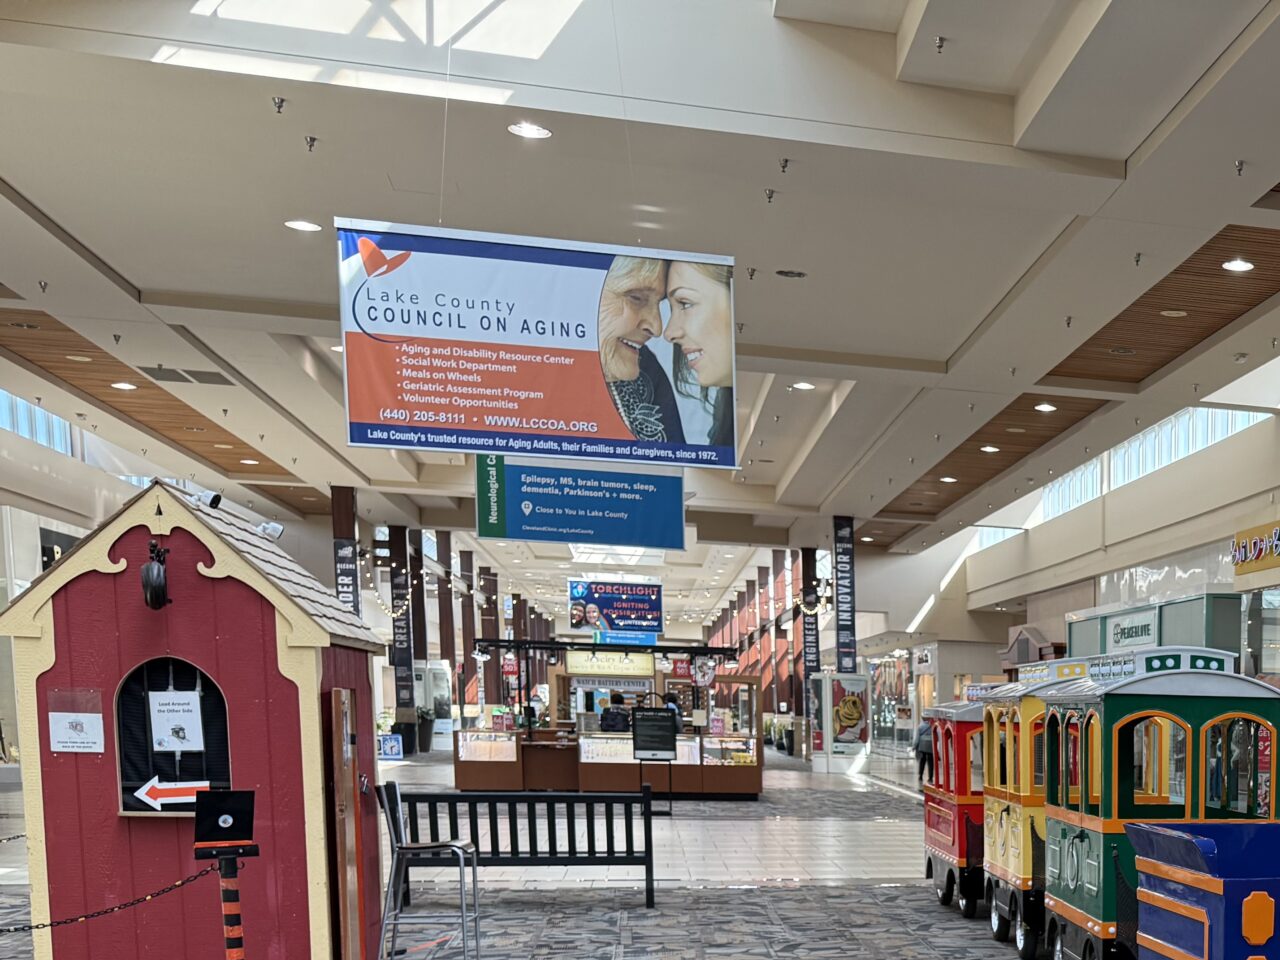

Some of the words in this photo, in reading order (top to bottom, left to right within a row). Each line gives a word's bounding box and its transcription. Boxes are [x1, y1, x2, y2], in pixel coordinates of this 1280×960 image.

[366, 287, 420, 305] Lake
[434, 293, 516, 316] County
[367, 305, 467, 329] COUNCIL
[480, 315, 507, 333] ON
[520, 318, 587, 339] AGING
[401, 343, 430, 356] Aging
[432, 345, 451, 355] and
[452, 346, 498, 361] Disability
[500, 350, 542, 363] Resource
[543, 354, 575, 366] Center
[401, 355, 430, 366] Social
[432, 357, 457, 369] Work
[459, 360, 517, 373] Department
[402, 368, 431, 379] Meals
[433, 372, 445, 380] on
[446, 370, 482, 383] Wheels
[402, 380, 445, 392] Geriatric
[446, 383, 502, 396] Assessment
[503, 387, 544, 400] Program
[402, 392, 451, 405] Volunteer
[452, 396, 519, 410] Opportunities
[379, 408, 411, 423] (440)
[413, 410, 466, 424] 205-8111
[483, 415, 599, 433] WWW.LCCOA.ORG
[367, 428, 389, 439] Lake
[389, 430, 426, 443] County's
[427, 432, 457, 444] trusted
[458, 436, 494, 446] resource
[495, 437, 508, 447] for
[508, 438, 532, 450] Aging
[533, 440, 561, 451] Adults,
[561, 442, 580, 452] their
[581, 443, 615, 455] Families
[615, 446, 631, 455] and
[631, 446, 675, 459] Caregivers,
[675, 449, 696, 459] since
[698, 451, 719, 461] 1972.
[521, 474, 558, 486] Epilepsy,
[559, 476, 576, 487] MS,
[577, 478, 599, 488] brain
[600, 480, 631, 491] tumors,
[633, 482, 657, 493] sleep,
[521, 484, 562, 496] dementia,
[563, 487, 610, 498] Parkinson's
[487, 466, 499, 524] Neurological
[535, 506, 554, 514] Close
[564, 507, 577, 515] You
[578, 508, 585, 516] in
[586, 509, 603, 518] Lake
[604, 510, 629, 520] County
[337, 575, 354, 612] ADER
[590, 584, 659, 595] TORCHLIGHT
[838, 554, 852, 625] INNOVATOR
[613, 601, 650, 609] IGNITING
[804, 616, 817, 667] ENGINEER
